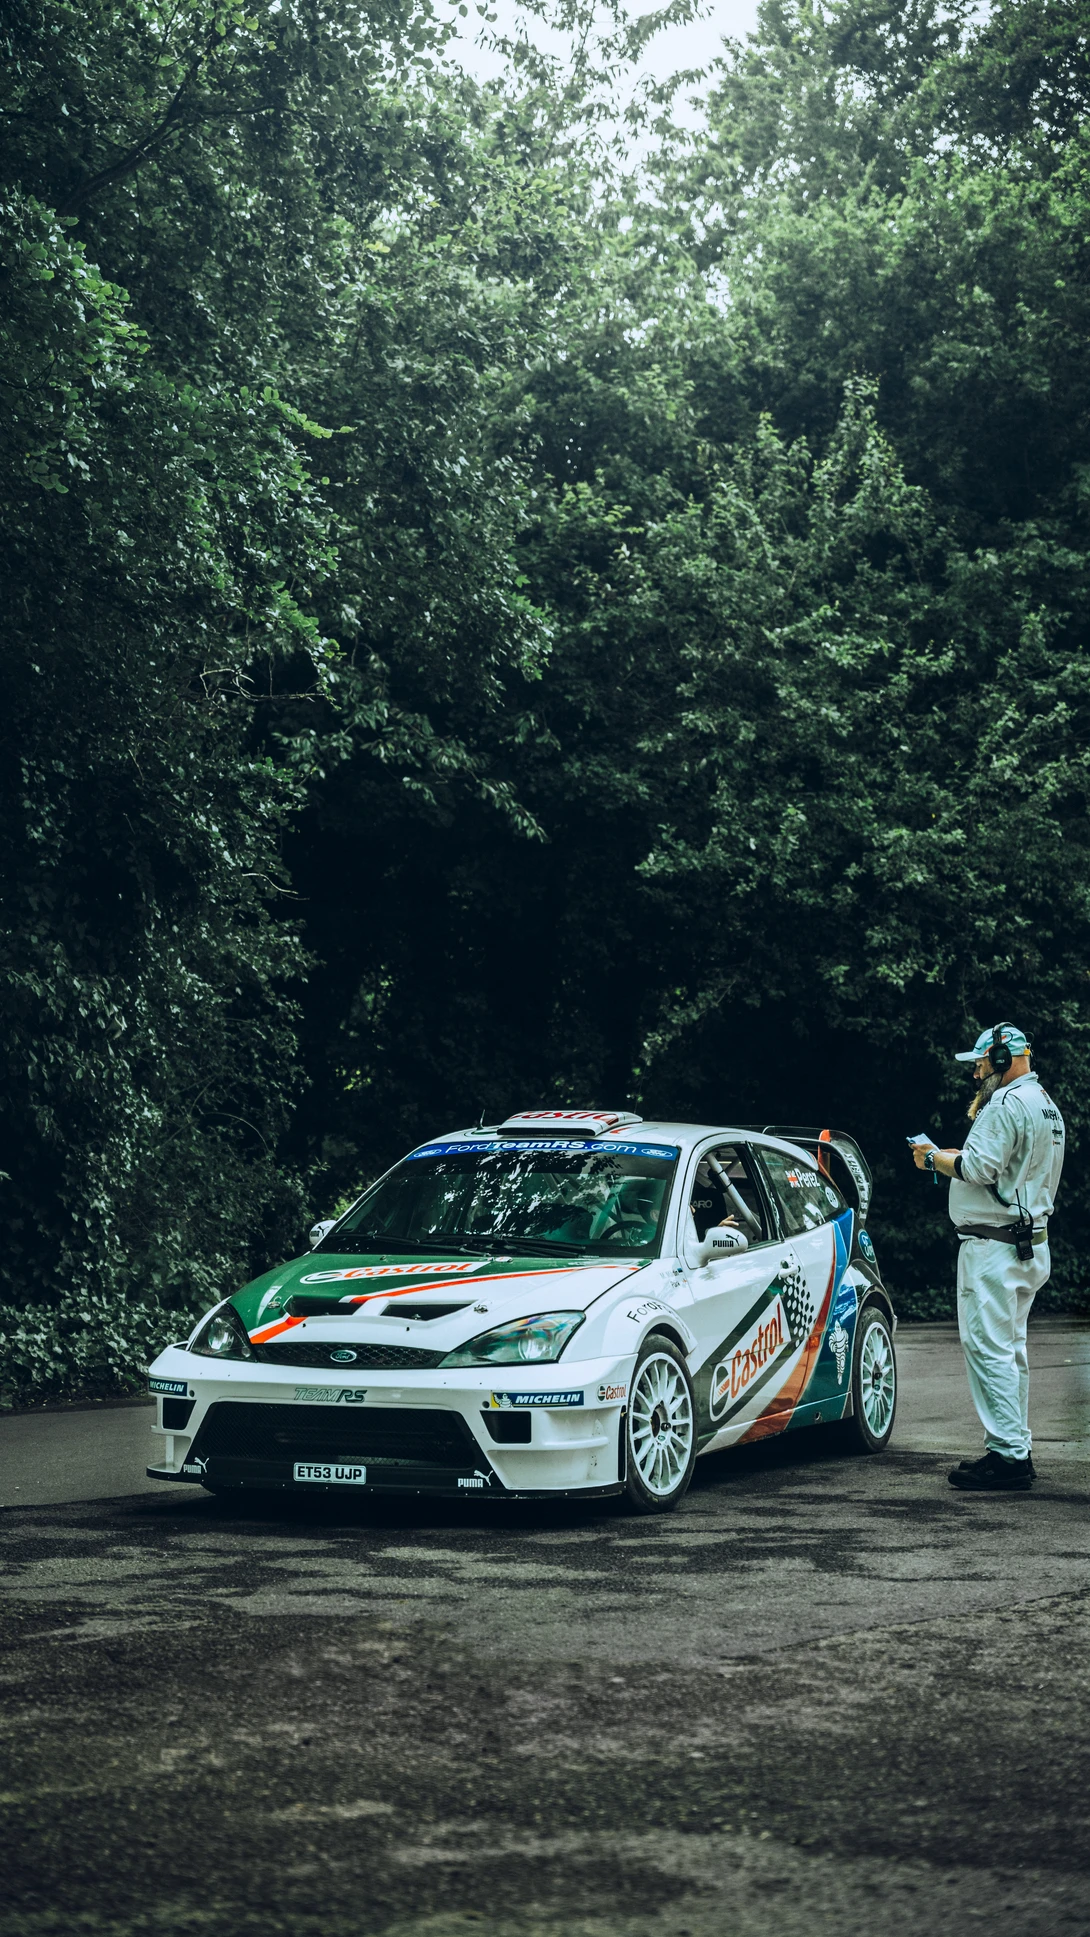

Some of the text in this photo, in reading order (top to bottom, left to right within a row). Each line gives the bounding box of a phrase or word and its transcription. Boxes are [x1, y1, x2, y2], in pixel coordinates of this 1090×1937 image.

[446, 1140, 637, 1154] FordTeamRS.com
[794, 1168, 821, 1188] Perez
[713, 1240, 734, 1248] PUMA
[344, 1263, 473, 1279] Castrol
[731, 1302, 784, 1399] Castrol
[149, 1380, 185, 1392] MICHELIN
[605, 1384, 627, 1400] Castrol
[515, 1393, 581, 1404] MICHELIN
[183, 1464, 202, 1474] PUMA
[297, 1466, 362, 1481] ET53 UJP
[457, 1478, 484, 1488] PUMA
